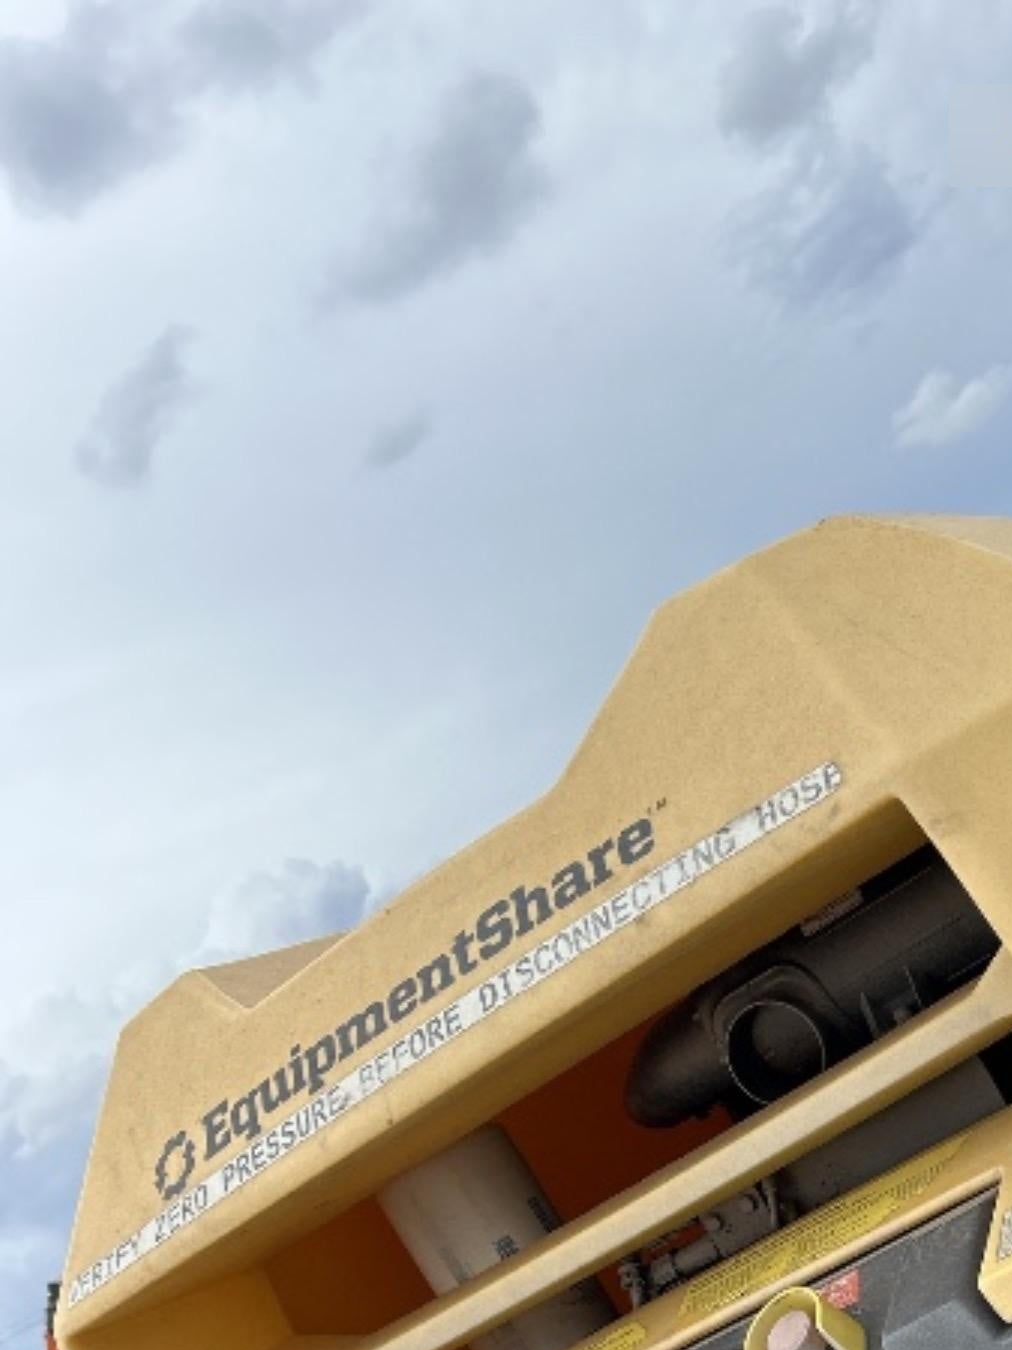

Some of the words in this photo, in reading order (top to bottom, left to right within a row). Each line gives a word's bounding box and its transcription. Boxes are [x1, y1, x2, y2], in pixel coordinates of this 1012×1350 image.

[154, 1185, 209, 1242] ZERO
[222, 1085, 348, 1192] PRESSURE
[478, 827, 737, 1013] DISCONNECTING
[203, 815, 656, 1160] EquipmentShare
